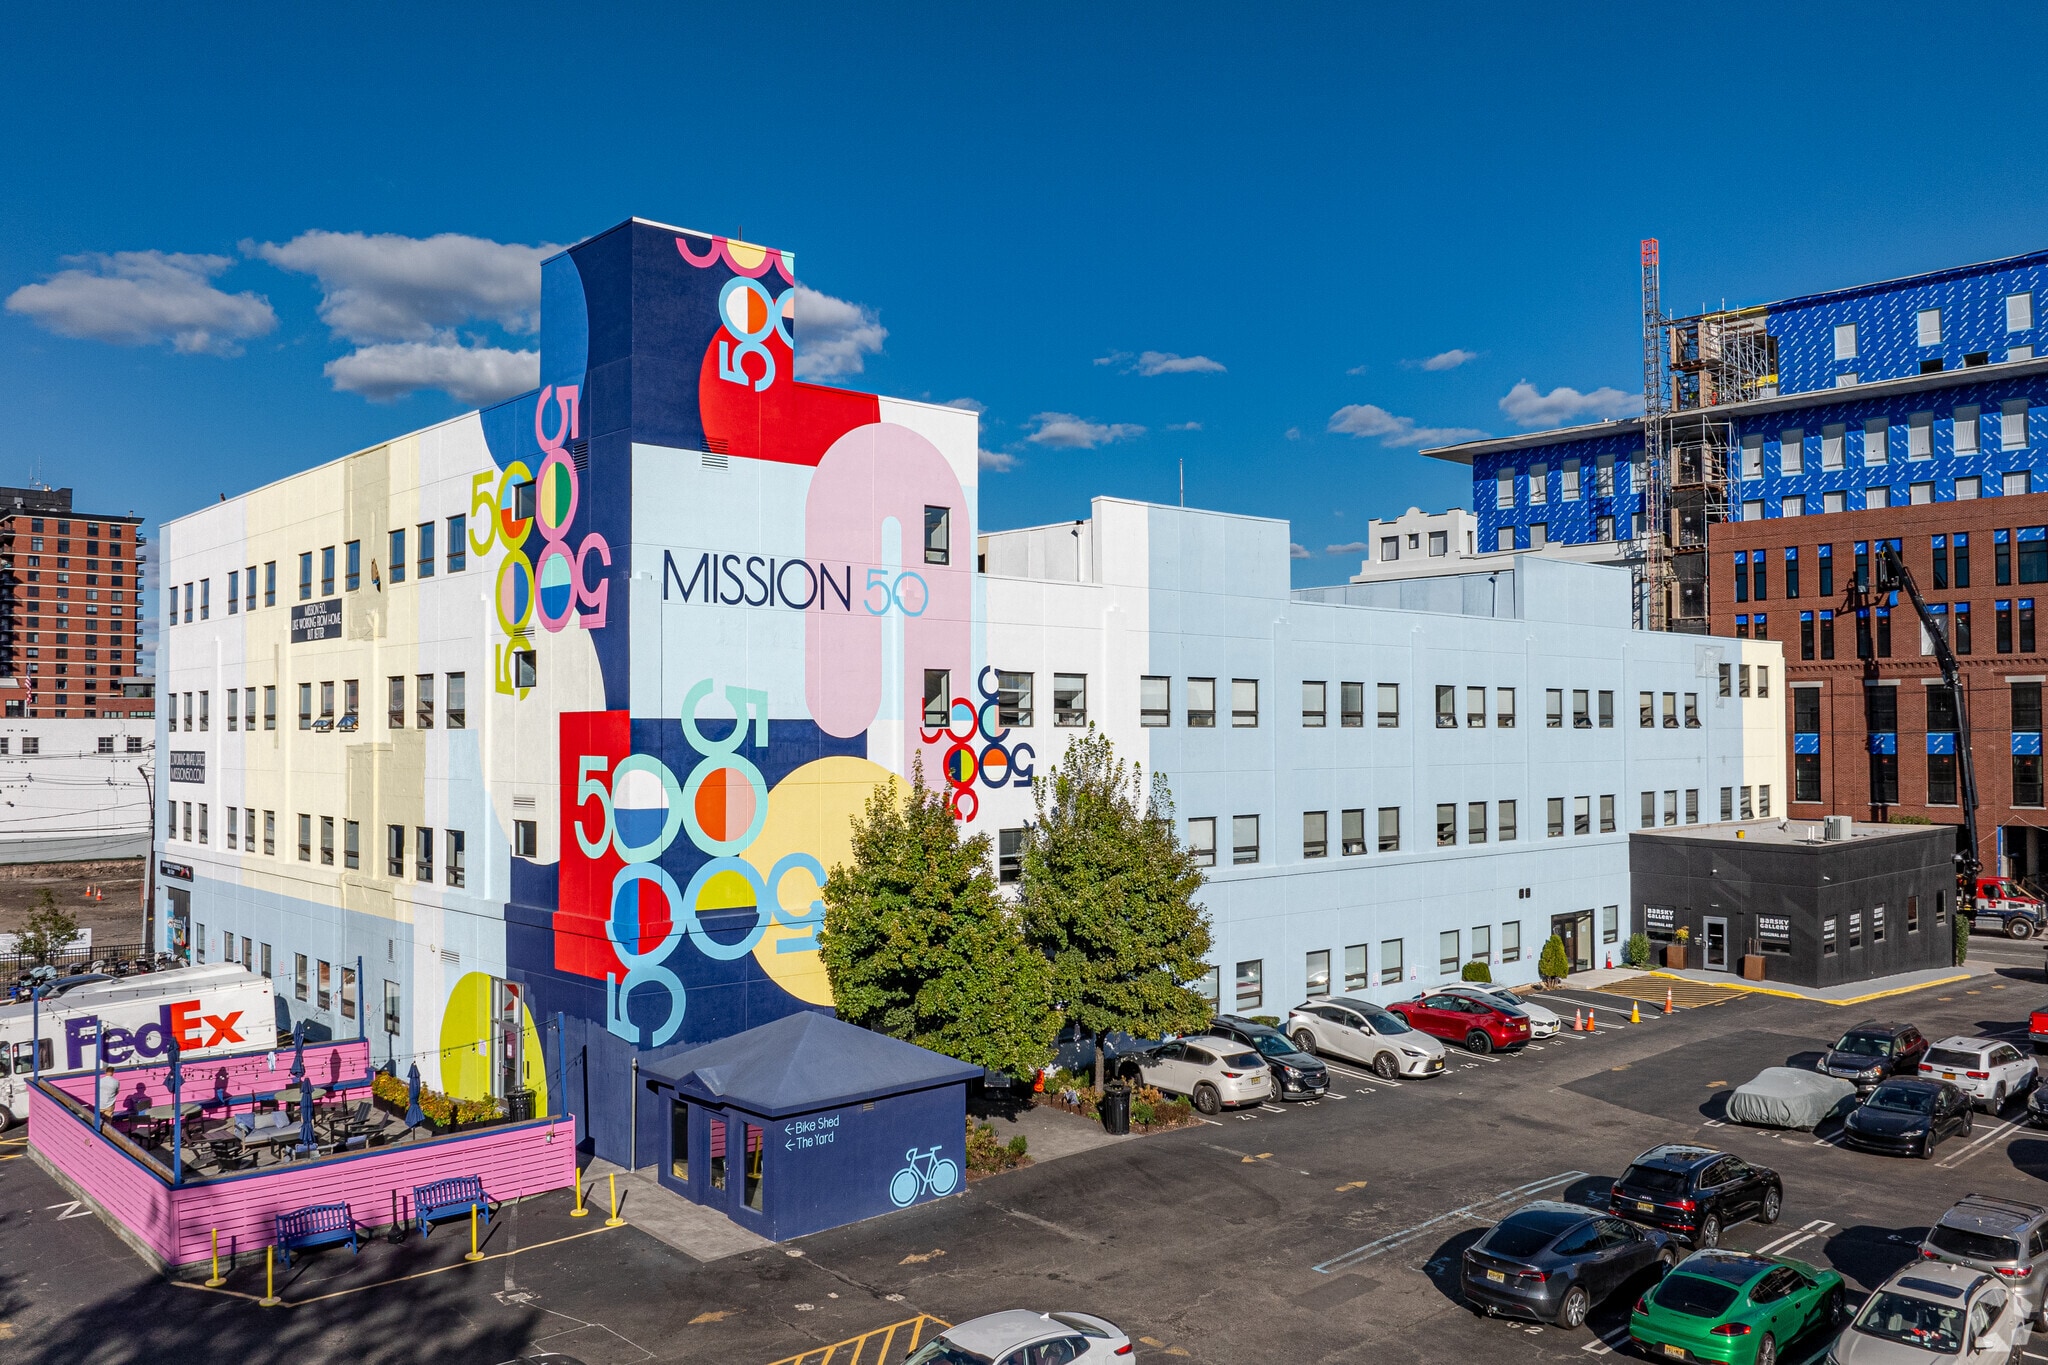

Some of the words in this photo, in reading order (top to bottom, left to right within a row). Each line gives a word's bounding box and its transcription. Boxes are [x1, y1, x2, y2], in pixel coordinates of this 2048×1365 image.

[663, 549, 850, 612] MISSION
[863, 568, 929, 618] 50
[328, 612, 341, 624] HOME
[65, 1000, 246, 1070] FedEx
[795, 1121, 815, 1134] Bike
[818, 1115, 839, 1129] Shed
[797, 1137, 813, 1149] The
[815, 1131, 834, 1145] Yard
